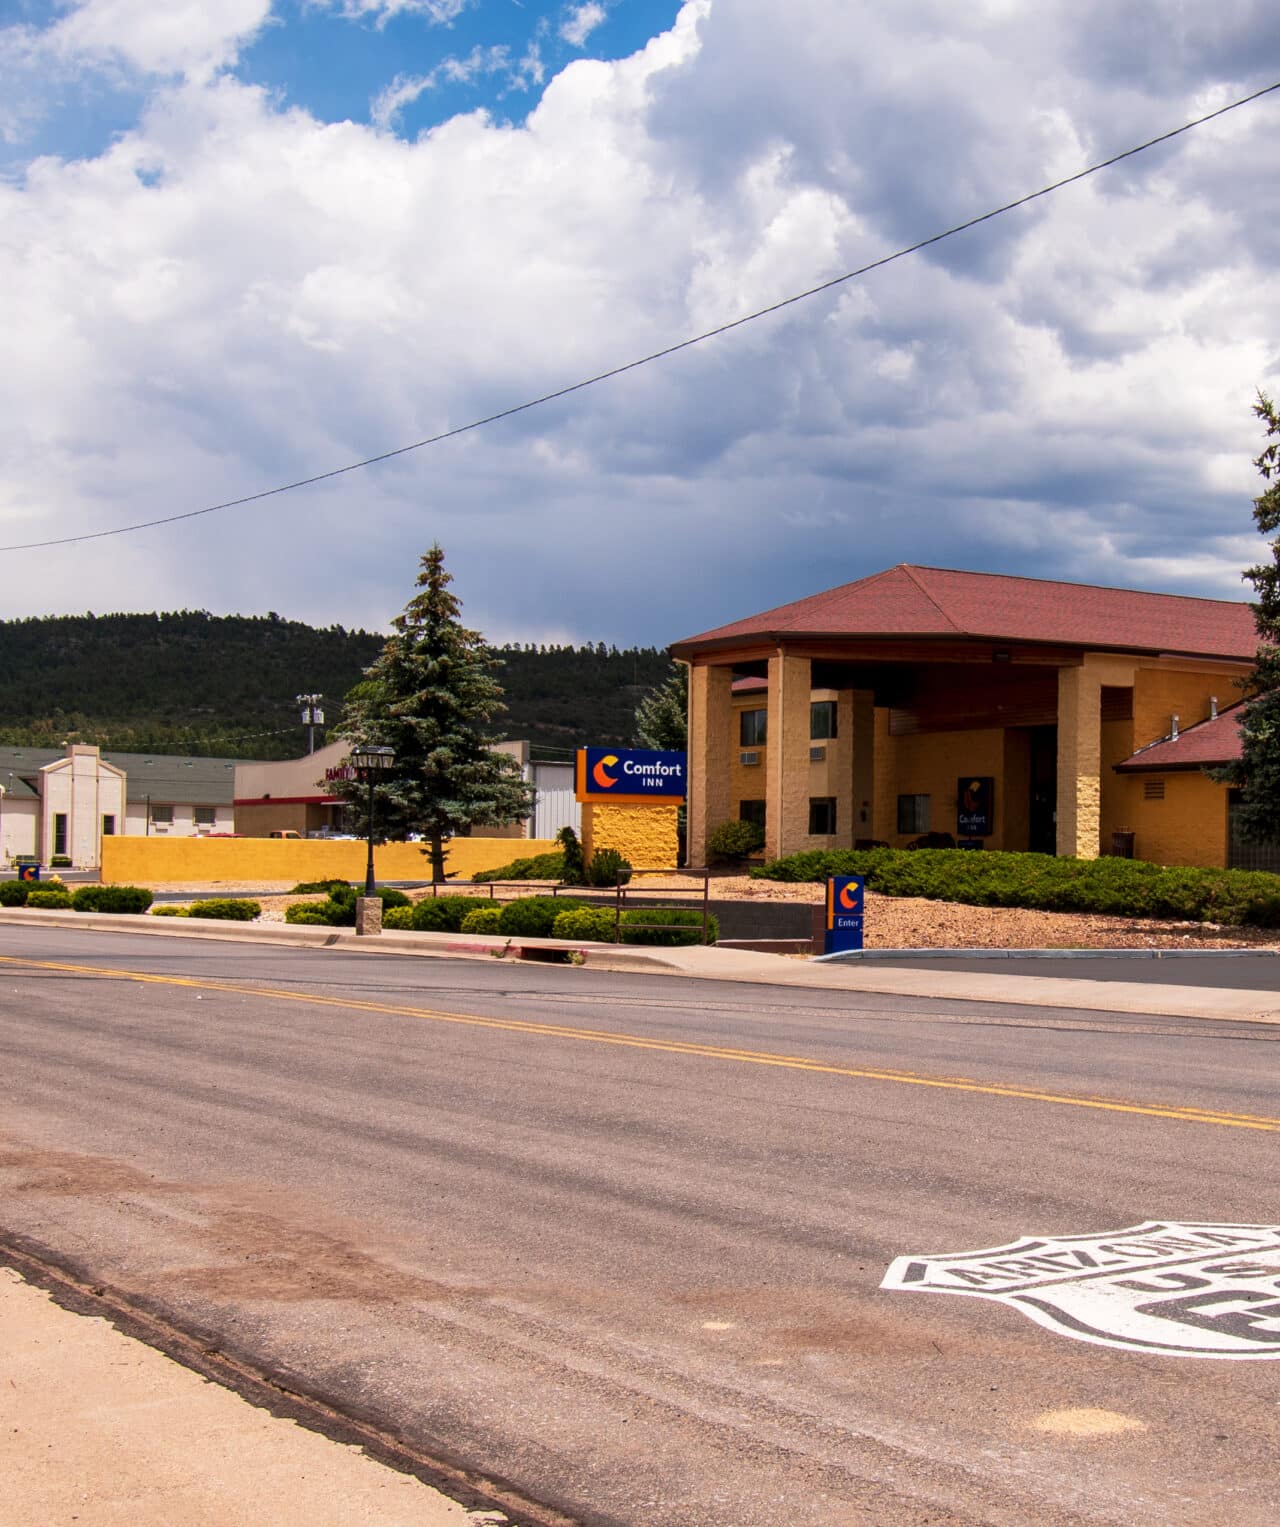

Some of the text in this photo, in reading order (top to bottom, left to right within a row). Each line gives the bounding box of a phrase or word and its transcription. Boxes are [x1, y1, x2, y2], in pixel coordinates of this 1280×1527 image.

[623, 760, 682, 777] Comfort
[642, 778, 664, 787] INN
[959, 814, 986, 824] Comfort
[838, 918, 860, 928] Enter
[944, 1231, 1266, 1285] ARIZONA
